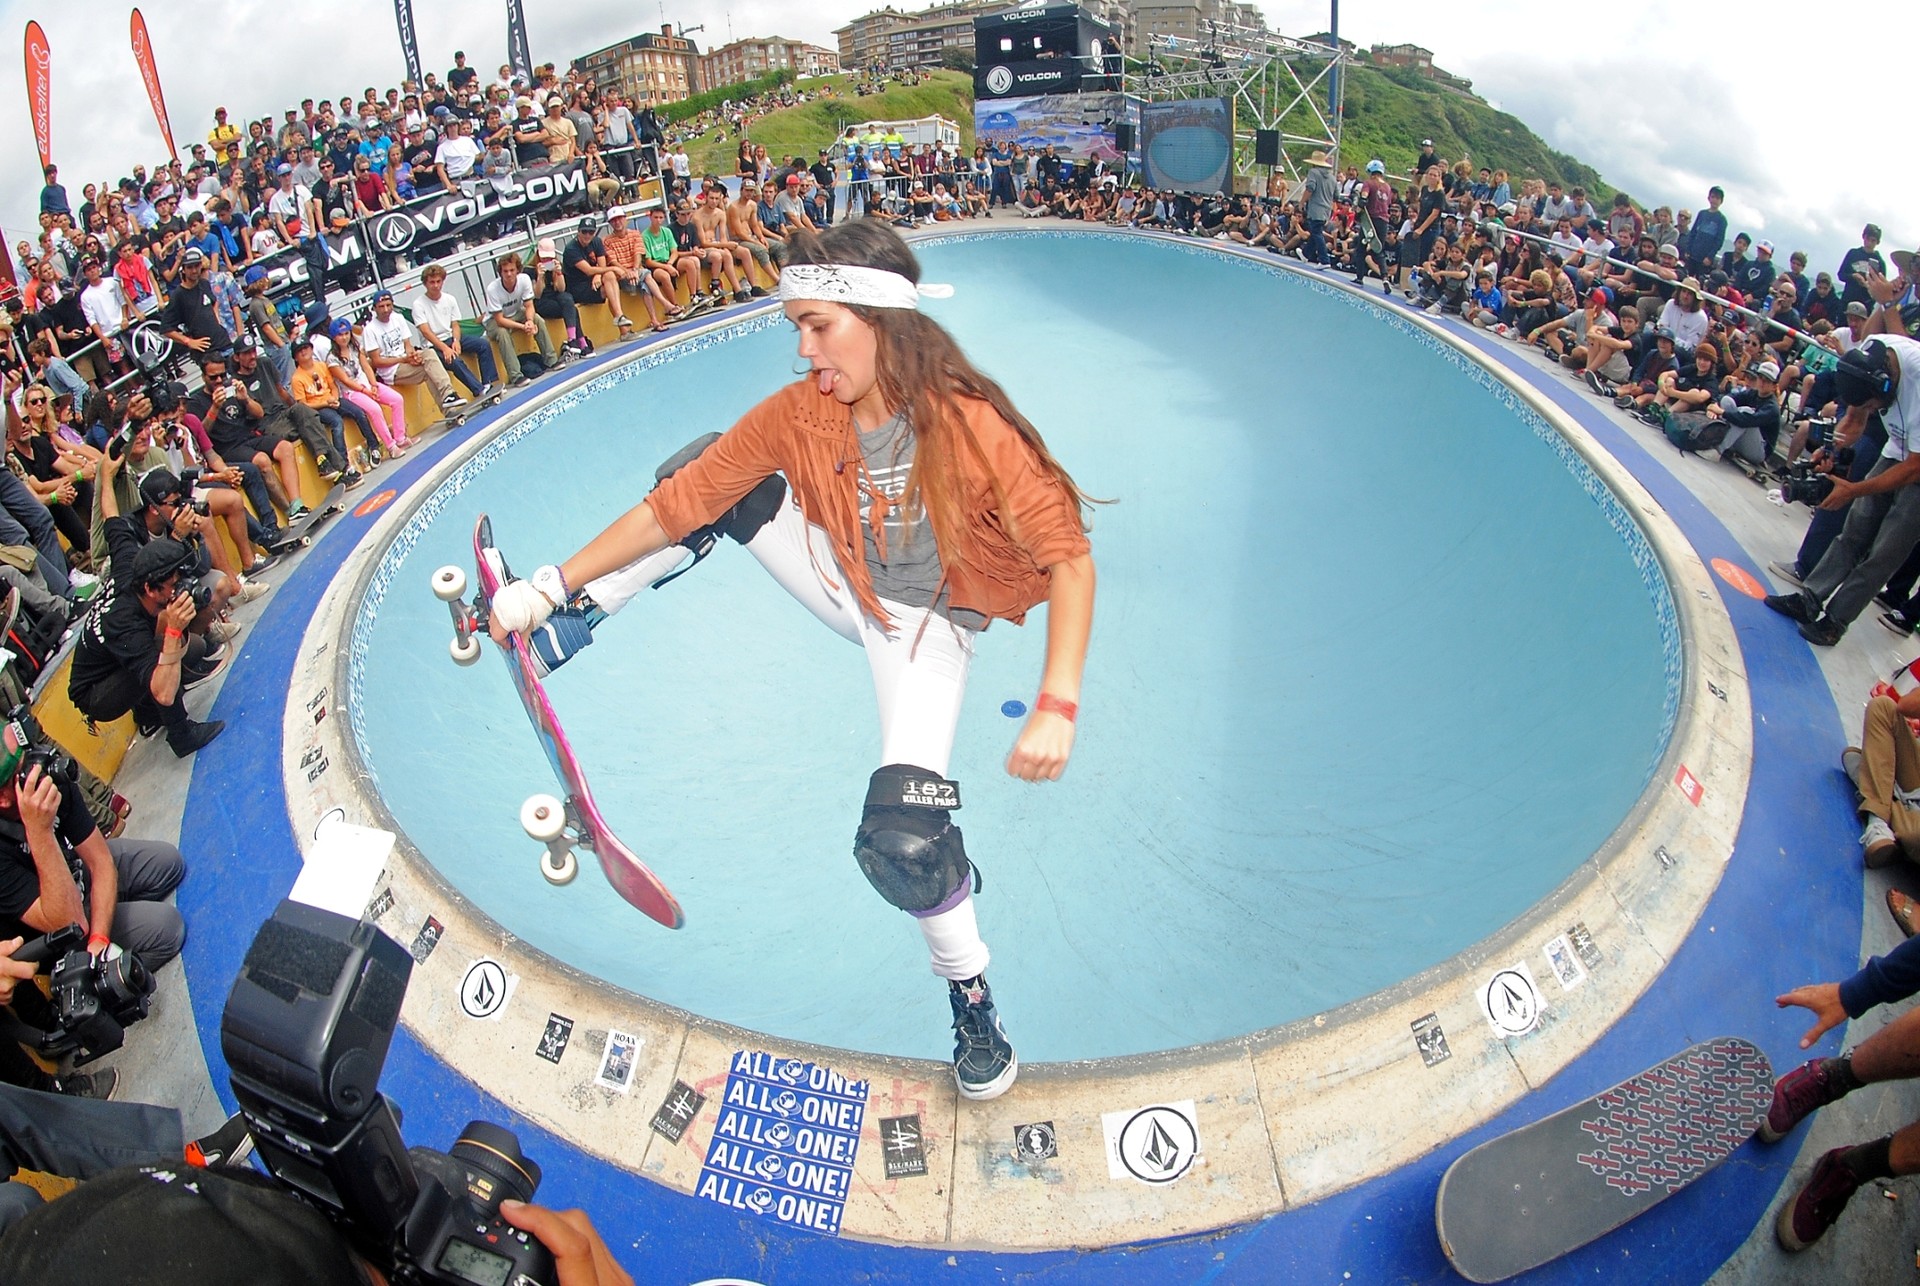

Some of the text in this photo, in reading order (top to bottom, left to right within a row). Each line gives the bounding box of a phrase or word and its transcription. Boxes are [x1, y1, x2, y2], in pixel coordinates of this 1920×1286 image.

[1002, 9, 1046, 21] VOLCOM
[1017, 71, 1062, 82] VOLCOM
[37, 71, 48, 155] euskaltel
[414, 169, 586, 232] VOLCOM
[902, 795, 957, 806] KILLER PADS
[906, 781, 955, 797] 187
[613, 1032, 636, 1046] HOAX
[734, 1051, 867, 1099] ALL ONE!
[727, 1078, 862, 1132] ALL ONE!
[719, 1111, 857, 1164] ALL ONE!
[709, 1142, 849, 1198] ALL ONE!
[699, 1174, 842, 1232] ALL ONE!
